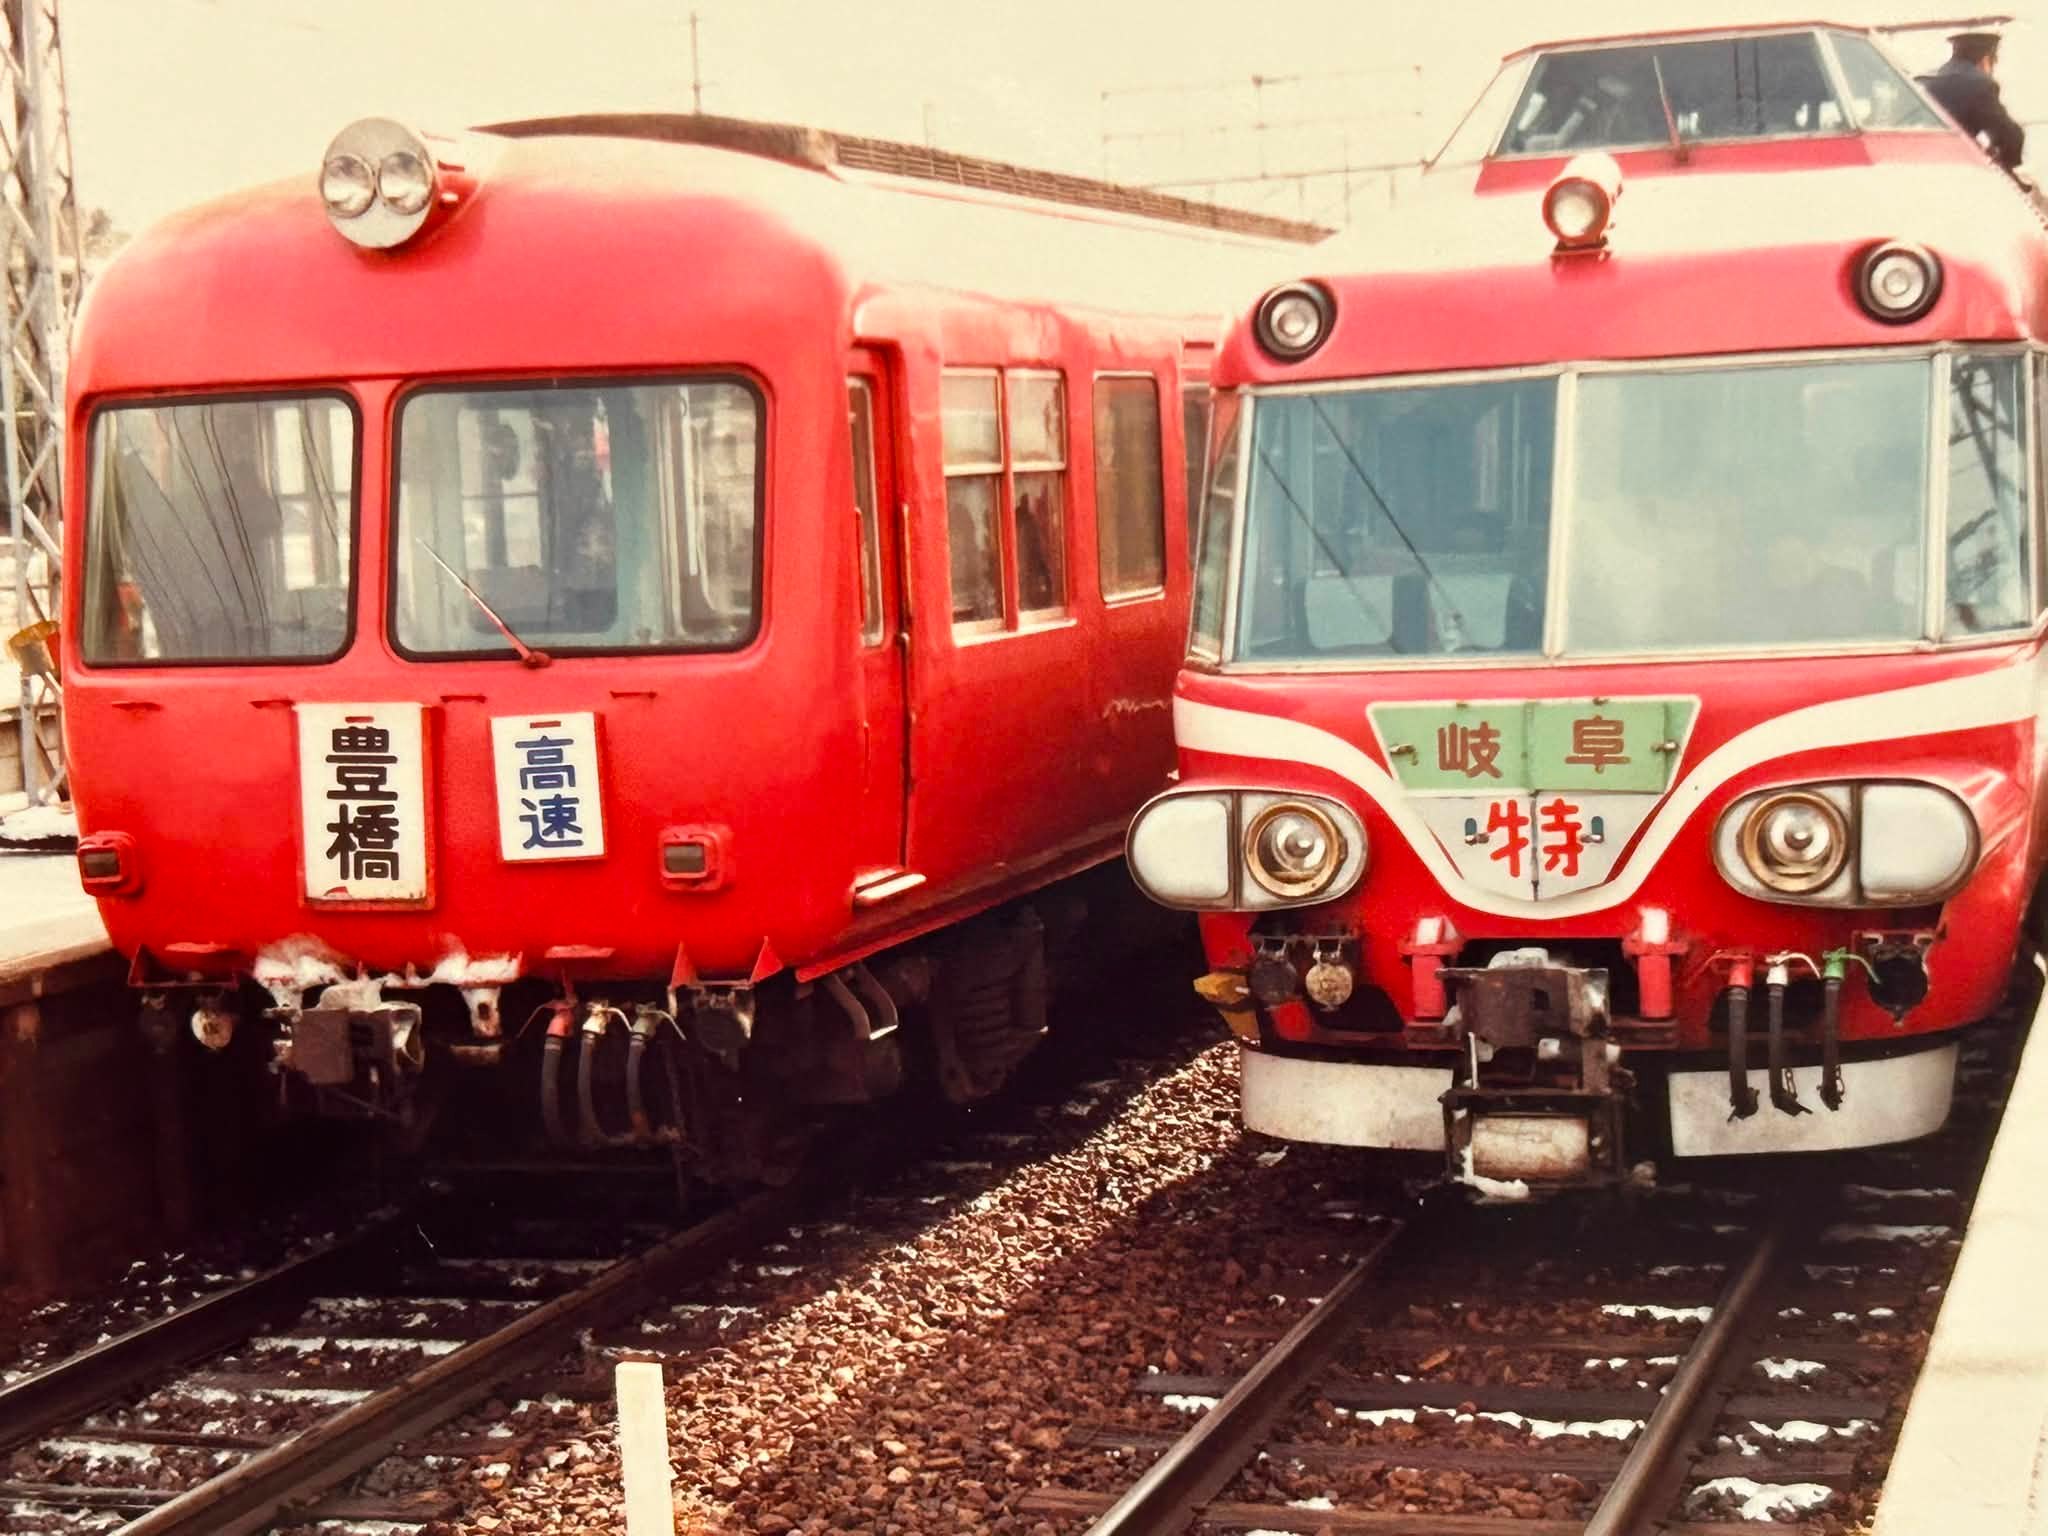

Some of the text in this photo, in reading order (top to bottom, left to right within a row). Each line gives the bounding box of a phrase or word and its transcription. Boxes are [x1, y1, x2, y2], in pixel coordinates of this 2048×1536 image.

[515, 735, 584, 849] 高速
[1437, 715, 1630, 778] 岐阜
[325, 726, 400, 881] 豊橋
[1487, 799, 1583, 878] 特
